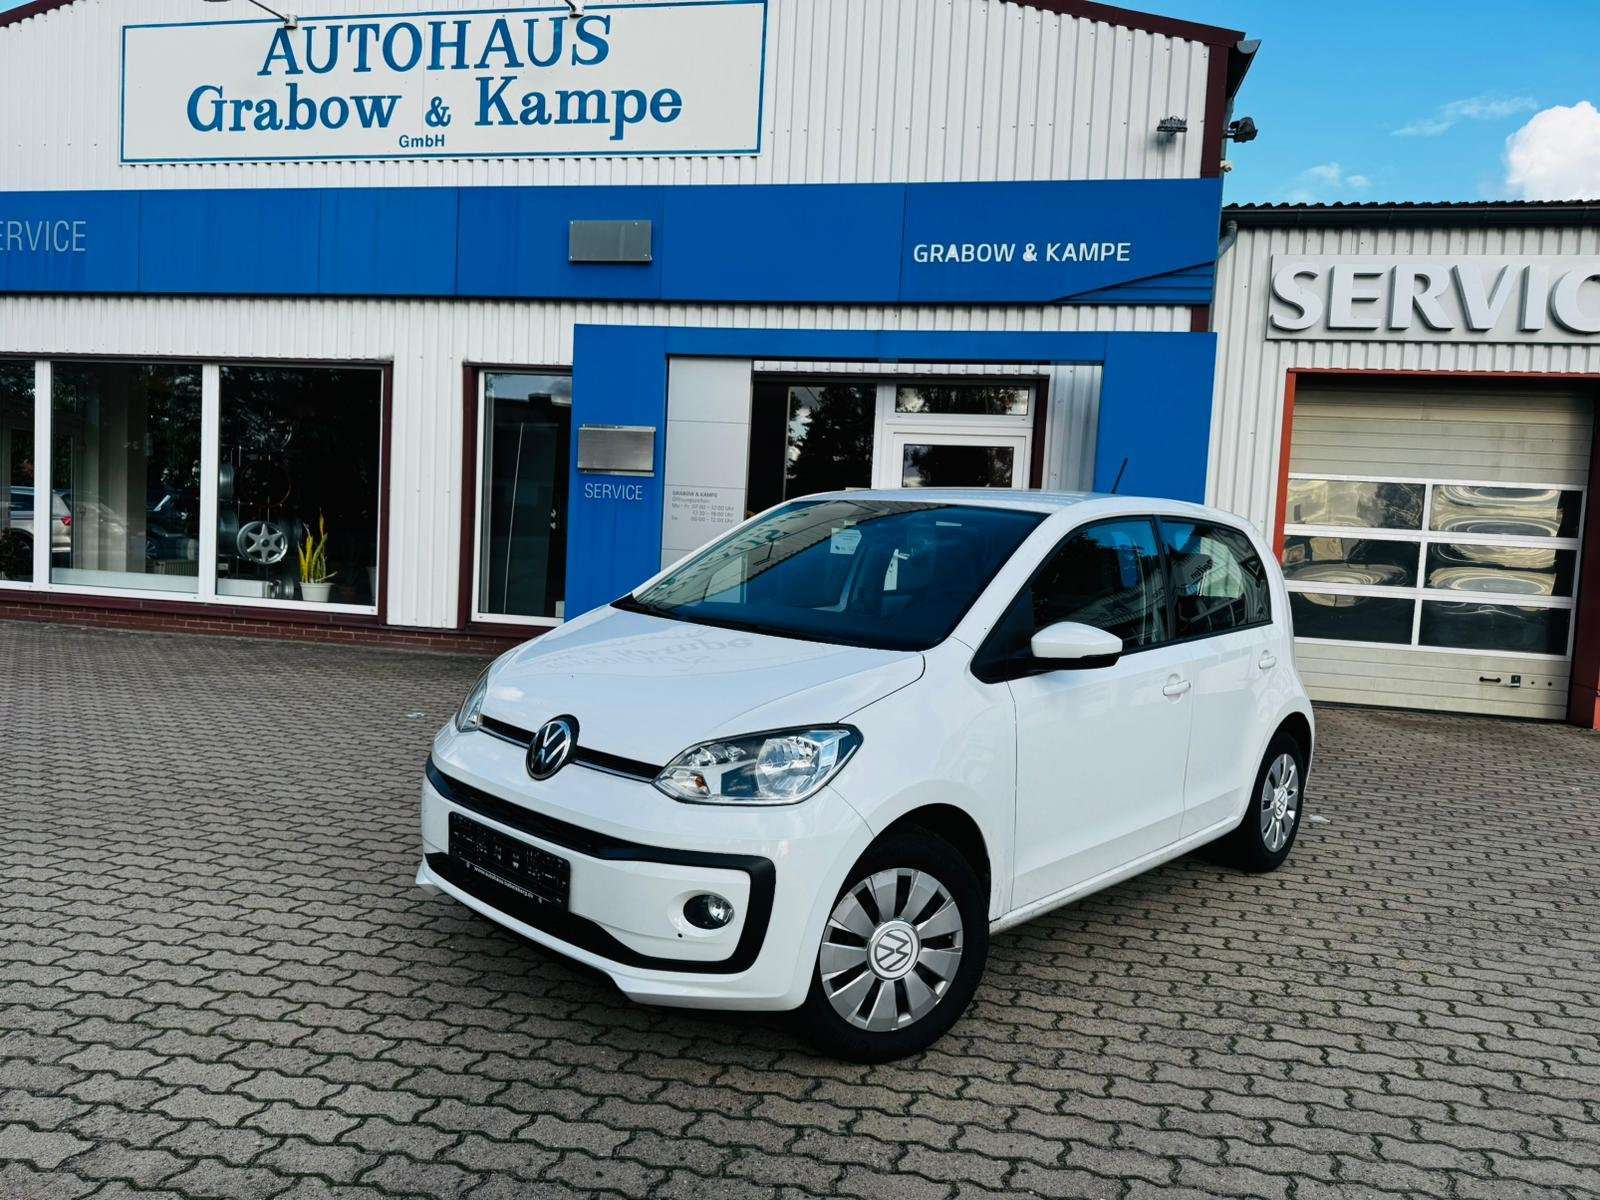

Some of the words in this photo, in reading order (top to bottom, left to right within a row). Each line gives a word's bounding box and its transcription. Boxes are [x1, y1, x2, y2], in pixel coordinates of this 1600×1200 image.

[257, 14, 612, 77] AUTOHAUS
[187, 83, 402, 132] Grabow
[425, 98, 452, 128] &
[474, 76, 683, 141] Kampe
[399, 134, 445, 148] GmbH
[0, 220, 87, 252] RVICE
[913, 243, 1016, 263] GRABOW
[1022, 243, 1038, 262] &
[1046, 242, 1131, 262] KAMPE
[584, 482, 644, 501] SERVICE
